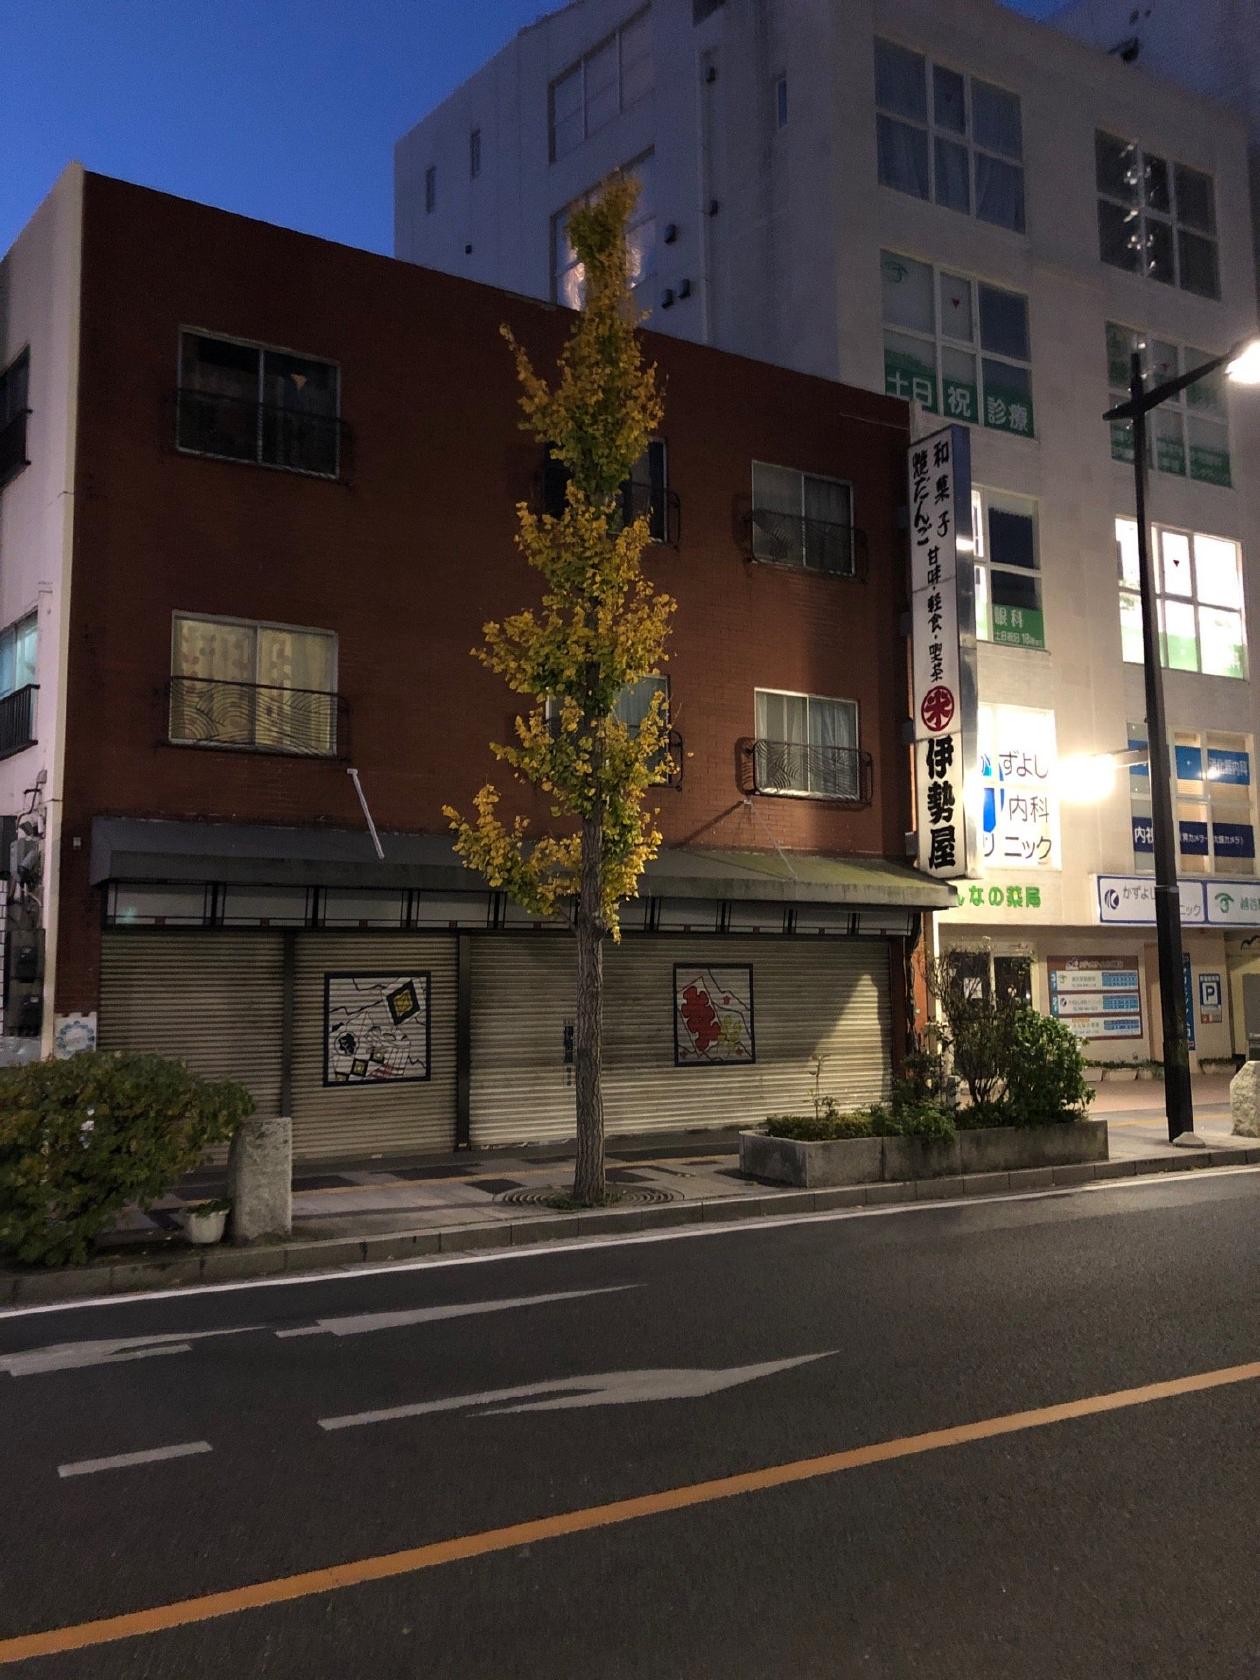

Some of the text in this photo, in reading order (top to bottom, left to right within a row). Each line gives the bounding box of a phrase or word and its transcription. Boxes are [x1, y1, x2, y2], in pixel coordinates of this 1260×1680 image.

[934, 441, 950, 538] 和菓子
[994, 606, 1023, 629] 眼科
[926, 735, 956, 870] 伊勢屋
[1009, 795, 1049, 822] 内科
[1205, 985, 1214, 1001] P
